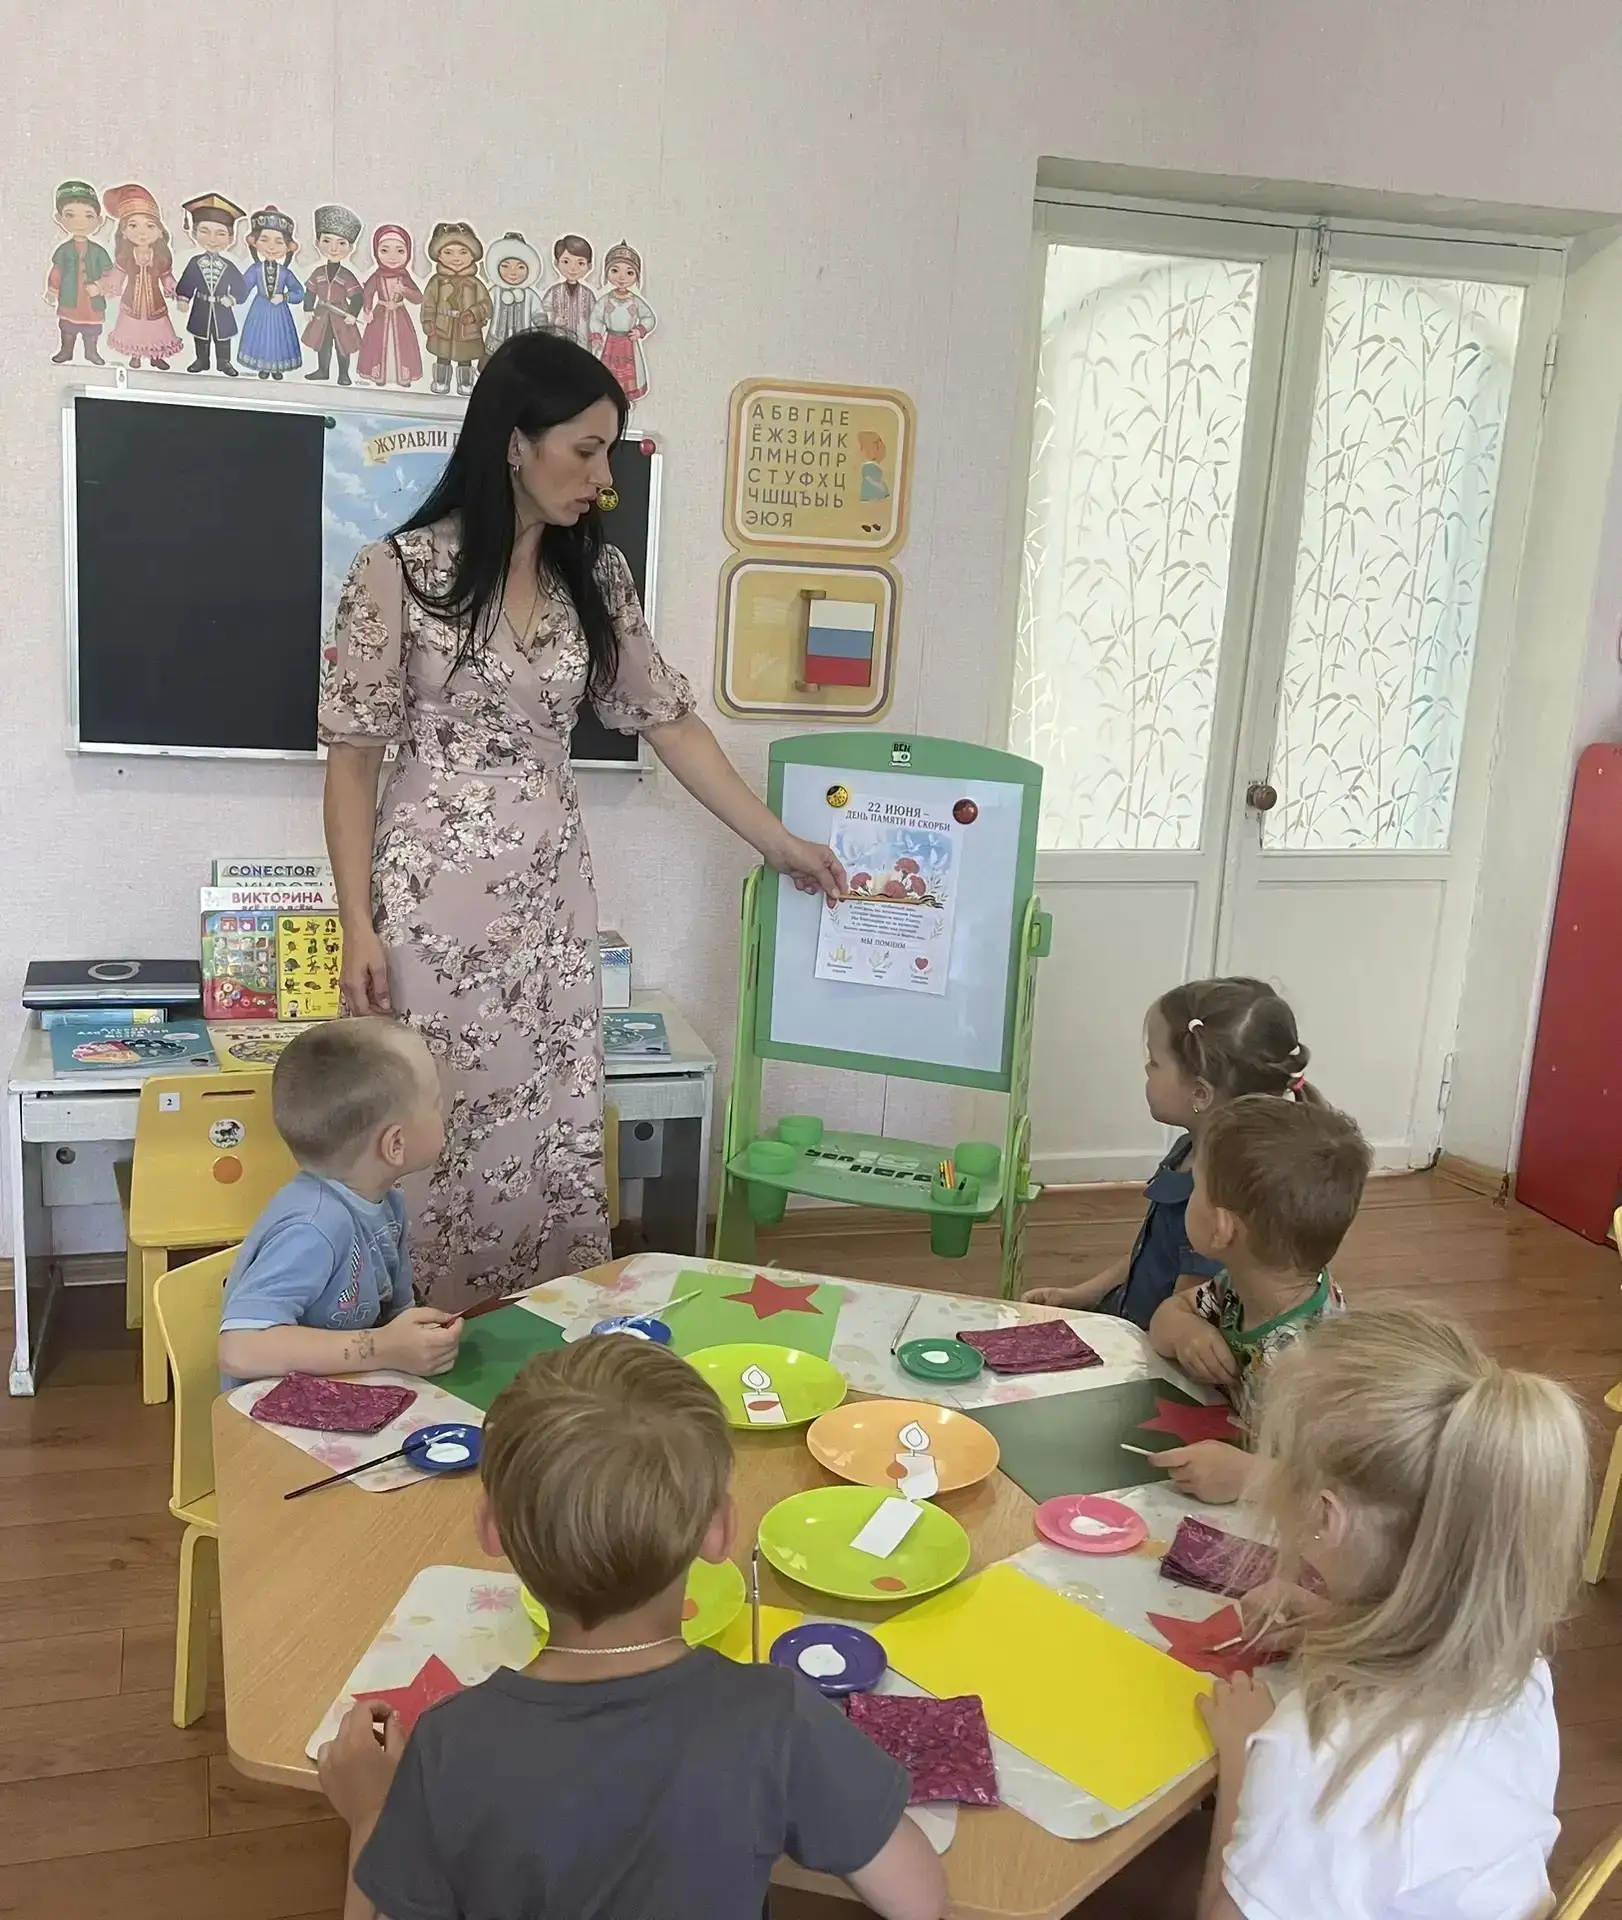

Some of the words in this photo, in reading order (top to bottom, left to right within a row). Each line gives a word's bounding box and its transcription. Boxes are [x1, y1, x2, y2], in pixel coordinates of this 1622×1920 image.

[373, 430, 447, 454] ЖУРАВЛИ
[893, 743, 911, 752] BEN
[868, 802, 881, 813] 22
[885, 804, 922, 818] ИЮНЯ
[846, 810, 868, 821] ДЕНЬ
[870, 813, 906, 827] ПАМЯТИ
[909, 819, 915, 827] И
[917, 820, 951, 832] СКОРБИ
[229, 865, 316, 877] CONECTOR
[232, 892, 323, 903] ВИКТОРИНА
[166, 1098, 173, 1106] 2
